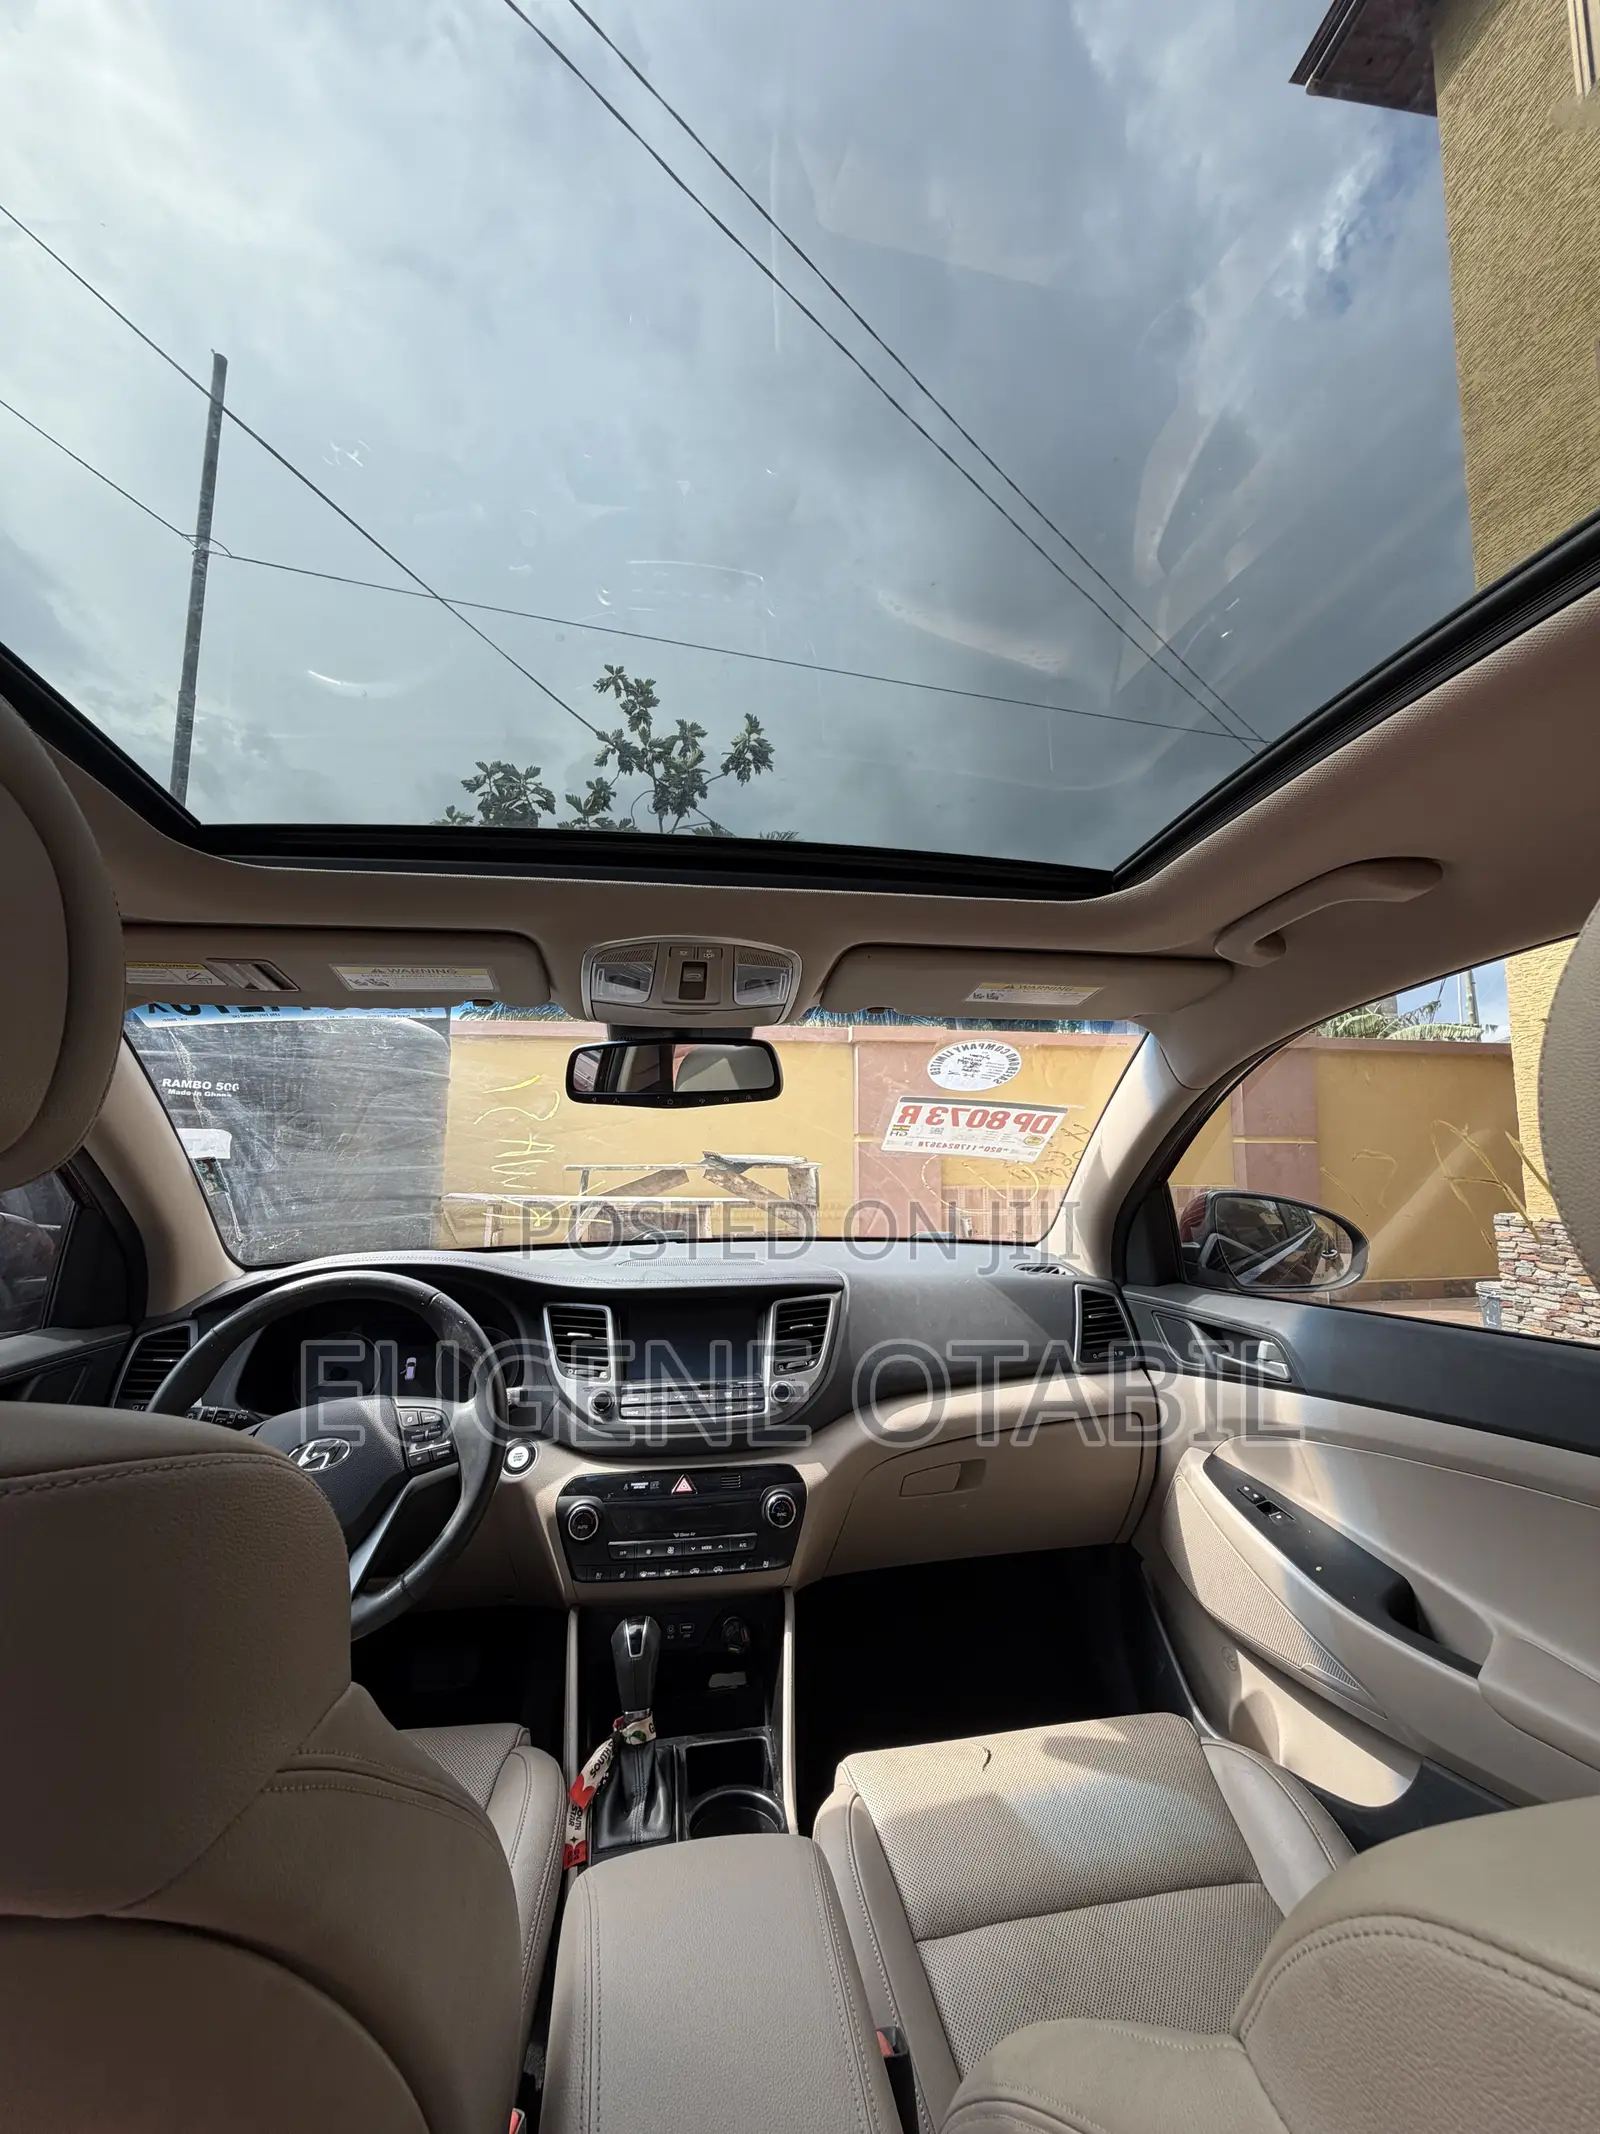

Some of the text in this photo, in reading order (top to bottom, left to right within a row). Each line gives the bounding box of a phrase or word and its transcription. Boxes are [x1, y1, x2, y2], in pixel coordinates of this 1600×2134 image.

[1019, 984, 1075, 992] WARNING
[162, 1078, 212, 1090] RAMBO
[168, 1088, 191, 1096] Made
[590, 1746, 613, 1779] SOUTH
[568, 1804, 577, 1827] STAR
